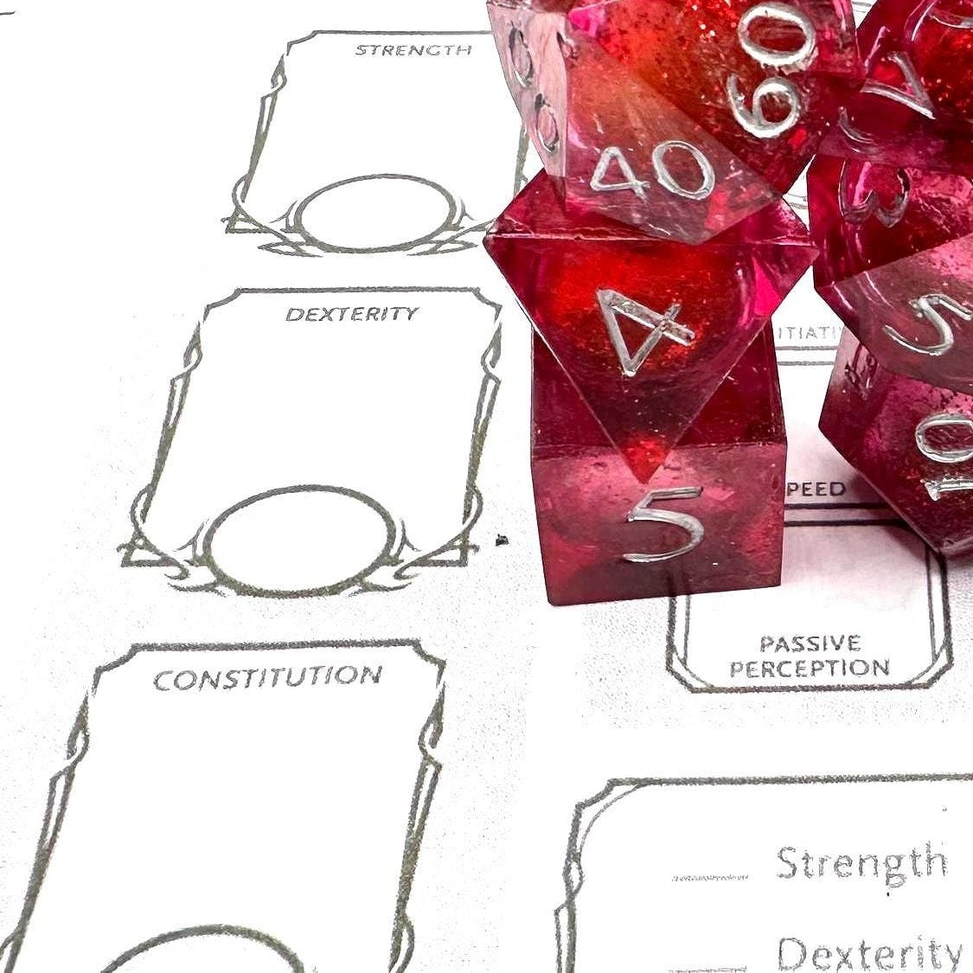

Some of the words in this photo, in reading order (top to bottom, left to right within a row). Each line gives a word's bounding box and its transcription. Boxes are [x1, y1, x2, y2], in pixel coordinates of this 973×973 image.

[355, 44, 473, 58] STRENGTH
[590, 140, 716, 207] 40
[285, 306, 420, 323] DEXTERITY
[596, 288, 698, 378] 4
[786, 481, 847, 497] PEED
[623, 485, 705, 564] 5
[760, 635, 862, 653] PASSIVE
[153, 664, 384, 692] CONSTITUTION
[729, 659, 890, 679] PERCEPTION
[777, 841, 948, 889] Strength
[778, 935, 964, 973] Dexterity
